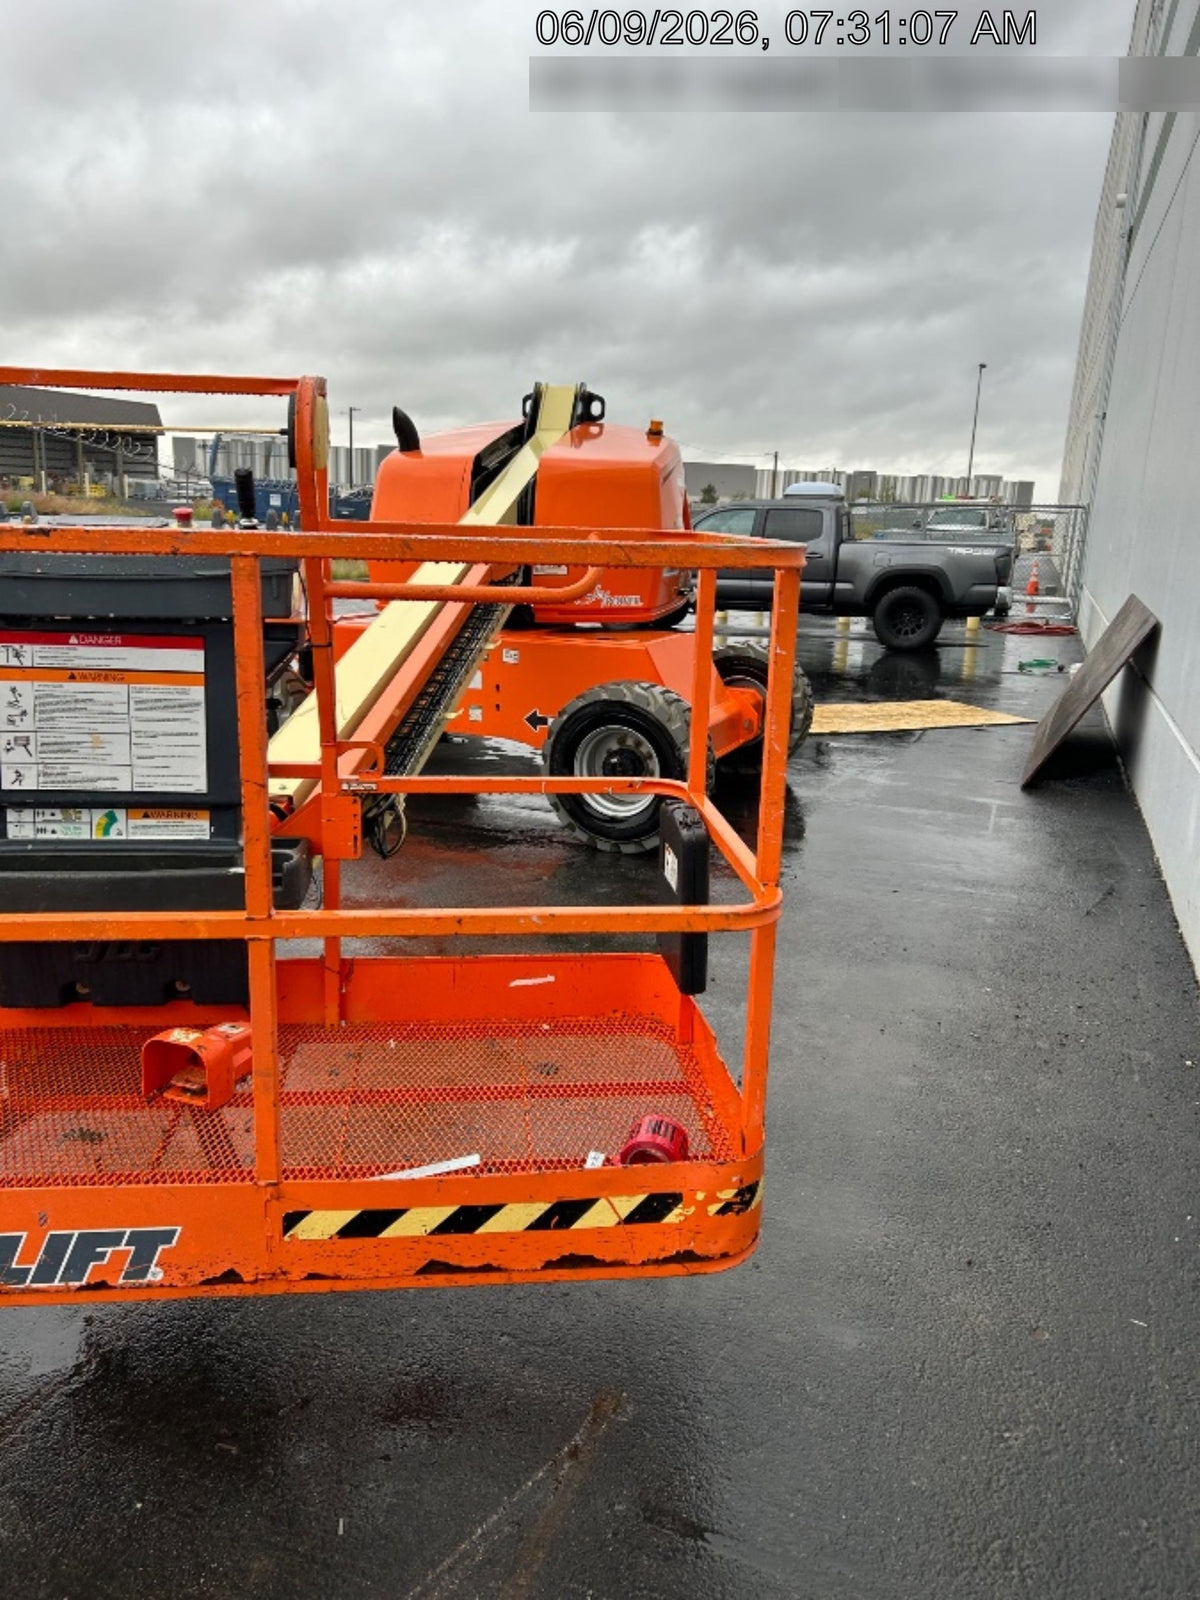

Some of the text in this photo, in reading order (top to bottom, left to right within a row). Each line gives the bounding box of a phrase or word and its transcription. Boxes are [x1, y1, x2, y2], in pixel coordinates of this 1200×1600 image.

[79, 634, 122, 646] DANGER
[77, 672, 126, 682] WARNING
[150, 810, 199, 820] WARNING
[0, 1226, 182, 1287] LIFT
